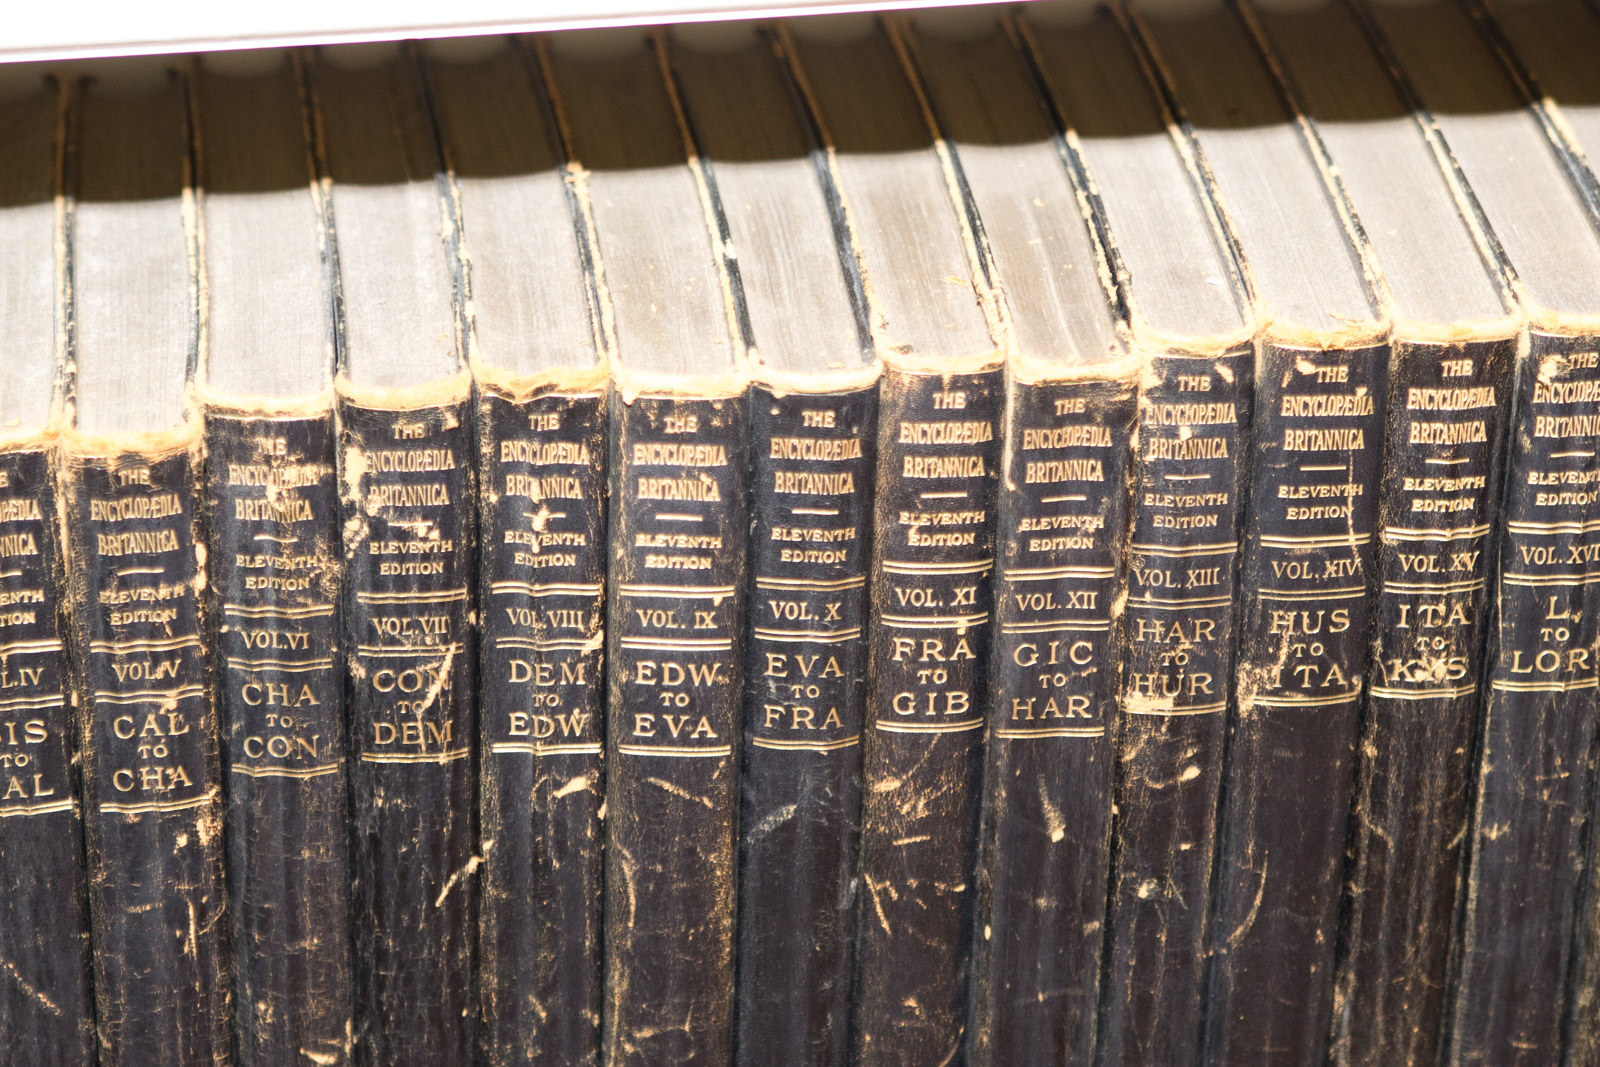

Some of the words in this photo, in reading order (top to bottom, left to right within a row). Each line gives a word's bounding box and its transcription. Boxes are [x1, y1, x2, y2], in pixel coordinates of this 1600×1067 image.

[1441, 360, 1473, 377] THE
[1568, 353, 1599, 369] THE
[1317, 366, 1349, 383] THE
[1178, 376, 1211, 392] THE
[933, 392, 966, 409] THE
[1055, 399, 1086, 415] THE
[529, 413, 560, 431] THE
[664, 415, 698, 433] THE
[802, 410, 836, 428] THE
[392, 423, 425, 440] THE
[1284, 430, 1364, 450] BRITANNICA
[1410, 421, 1487, 445] BRITANNICA
[256, 438, 287, 455] THE
[1150, 438, 1228, 460] BRITANNICA
[228, 463, 319, 489] ENCYCOPDIA
[903, 456, 985, 478] BRITANNICA
[1025, 460, 1104, 483] BRITANNICA
[119, 468, 150, 486] THE
[774, 471, 854, 495] BRITANNICA
[1403, 476, 1485, 492] ELEVENTH
[370, 484, 450, 507] BRITANNICA
[506, 475, 583, 501] BRITANNICA
[638, 478, 720, 501] BRITANNICA
[1278, 484, 1363, 499] ELEVENTH
[1144, 494, 1228, 507] ELEVENTH
[1411, 499, 1475, 512] EDITION
[1536, 491, 1598, 506] EDITION
[235, 498, 314, 522] BRITANNICA
[899, 511, 985, 525] ELEVENTH
[1286, 506, 1352, 520] EDITION
[1021, 516, 1104, 532] ELEVENTH
[1153, 515, 1218, 528] EDITION
[98, 529, 179, 556] BRITANNICA
[504, 531, 586, 547] ELEVENTH
[635, 533, 722, 549] ELEVENTH
[771, 527, 855, 542] ELEVENTH
[908, 533, 975, 546] EDITION
[370, 540, 453, 555] ELEVENTH
[1029, 538, 1094, 551] EDITION
[236, 554, 318, 569] ELEVENTH
[514, 553, 576, 568] EDITION
[645, 555, 712, 569] EDITION
[781, 550, 847, 563] EDITION
[380, 561, 443, 575] EDITION
[246, 576, 310, 590] EDITION
[1187, 568, 1221, 588] XIII
[100, 584, 186, 604] ELEVENTH
[895, 588, 943, 607] VOL.
[950, 587, 977, 605] XI
[1066, 591, 1098, 610] XII
[110, 608, 177, 626] EDITION
[769, 600, 819, 621] VOL.
[825, 603, 842, 621] X
[1397, 605, 1471, 628] ITA
[1546, 596, 1570, 620] L
[636, 609, 686, 629] VOL.
[694, 612, 718, 629] IX
[1270, 609, 1350, 635] HUS
[1136, 619, 1216, 643] HAR
[1541, 628, 1570, 642] TO
[892, 638, 976, 662] FRA
[1292, 643, 1324, 657] TO
[1417, 637, 1444, 651] TO
[1013, 642, 1093, 667] GIC
[1161, 652, 1188, 666] TO
[1511, 648, 1590, 673] LOR
[509, 659, 586, 686] DEM
[636, 660, 721, 686] EDW
[765, 653, 844, 678] EVA
[373, 668, 450, 692] CON
[917, 669, 947, 684] TO
[1039, 673, 1067, 688] TO
[1134, 673, 1214, 696] HUR
[1272, 664, 1347, 688] ITA
[242, 683, 320, 707] CHA
[533, 693, 560, 707] TO
[659, 692, 689, 707] TO
[791, 685, 819, 698] TO
[398, 700, 424, 714] TO
[892, 692, 970, 715] GIB
[1011, 696, 1092, 720] HAR
[113, 713, 189, 739] CAL
[266, 714, 294, 728] TO
[509, 712, 589, 738] EDW
[633, 713, 718, 738] EVA
[764, 704, 844, 730] FRA
[0, 720, 47, 745] IS
[373, 721, 453, 745] DEM
[138, 745, 168, 759] TO
[243, 734, 320, 759] CON
[1, 754, 29, 768] TO
[113, 766, 193, 792] CHA
